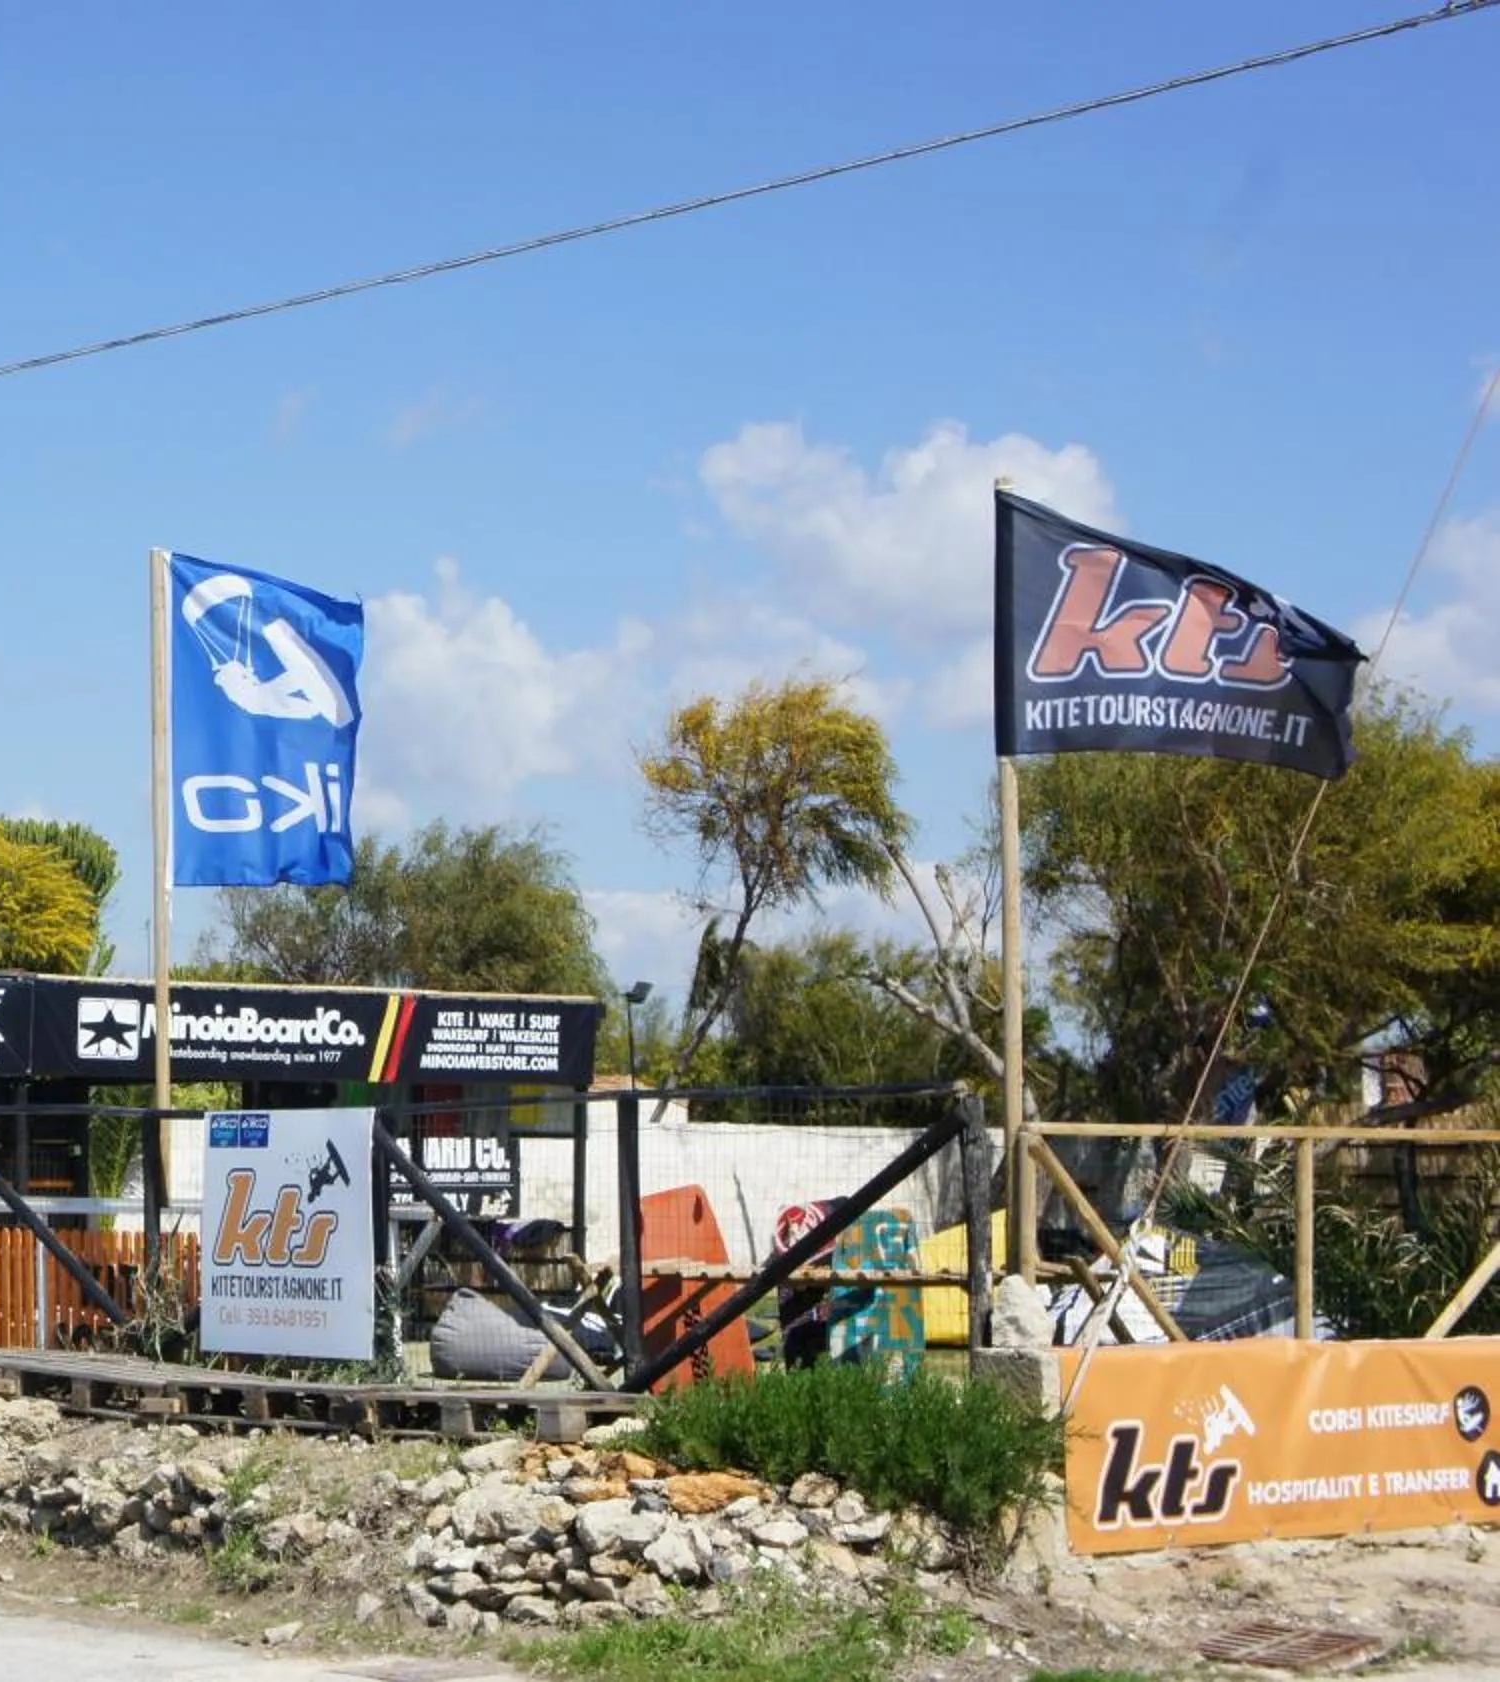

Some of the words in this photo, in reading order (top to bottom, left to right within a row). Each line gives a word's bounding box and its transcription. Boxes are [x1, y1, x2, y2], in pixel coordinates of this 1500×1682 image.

[1026, 541, 1293, 691] kts
[1026, 693, 1312, 747] KITETOURSTAGNONE.IT
[432, 1028, 489, 1041] WAKESURF
[499, 1030, 559, 1044] WAKESKATE
[437, 1011, 464, 1026] KITE
[478, 1012, 516, 1028] WAKE
[529, 1014, 560, 1030] SURF
[168, 1044, 227, 1063] kateboarding
[294, 1051, 315, 1063] since
[318, 1050, 342, 1063] 1977
[212, 1168, 339, 1267] kts
[211, 1274, 343, 1301] KITETOURSTAGNONE.IT
[1308, 1405, 1363, 1433] CORSI
[1367, 1403, 1450, 1428] KITESURF
[1094, 1419, 1241, 1531] kts
[1247, 1474, 1363, 1505] HOSPITALITY
[1368, 1475, 1380, 1497] E
[1384, 1467, 1470, 1494] TRANSFER
